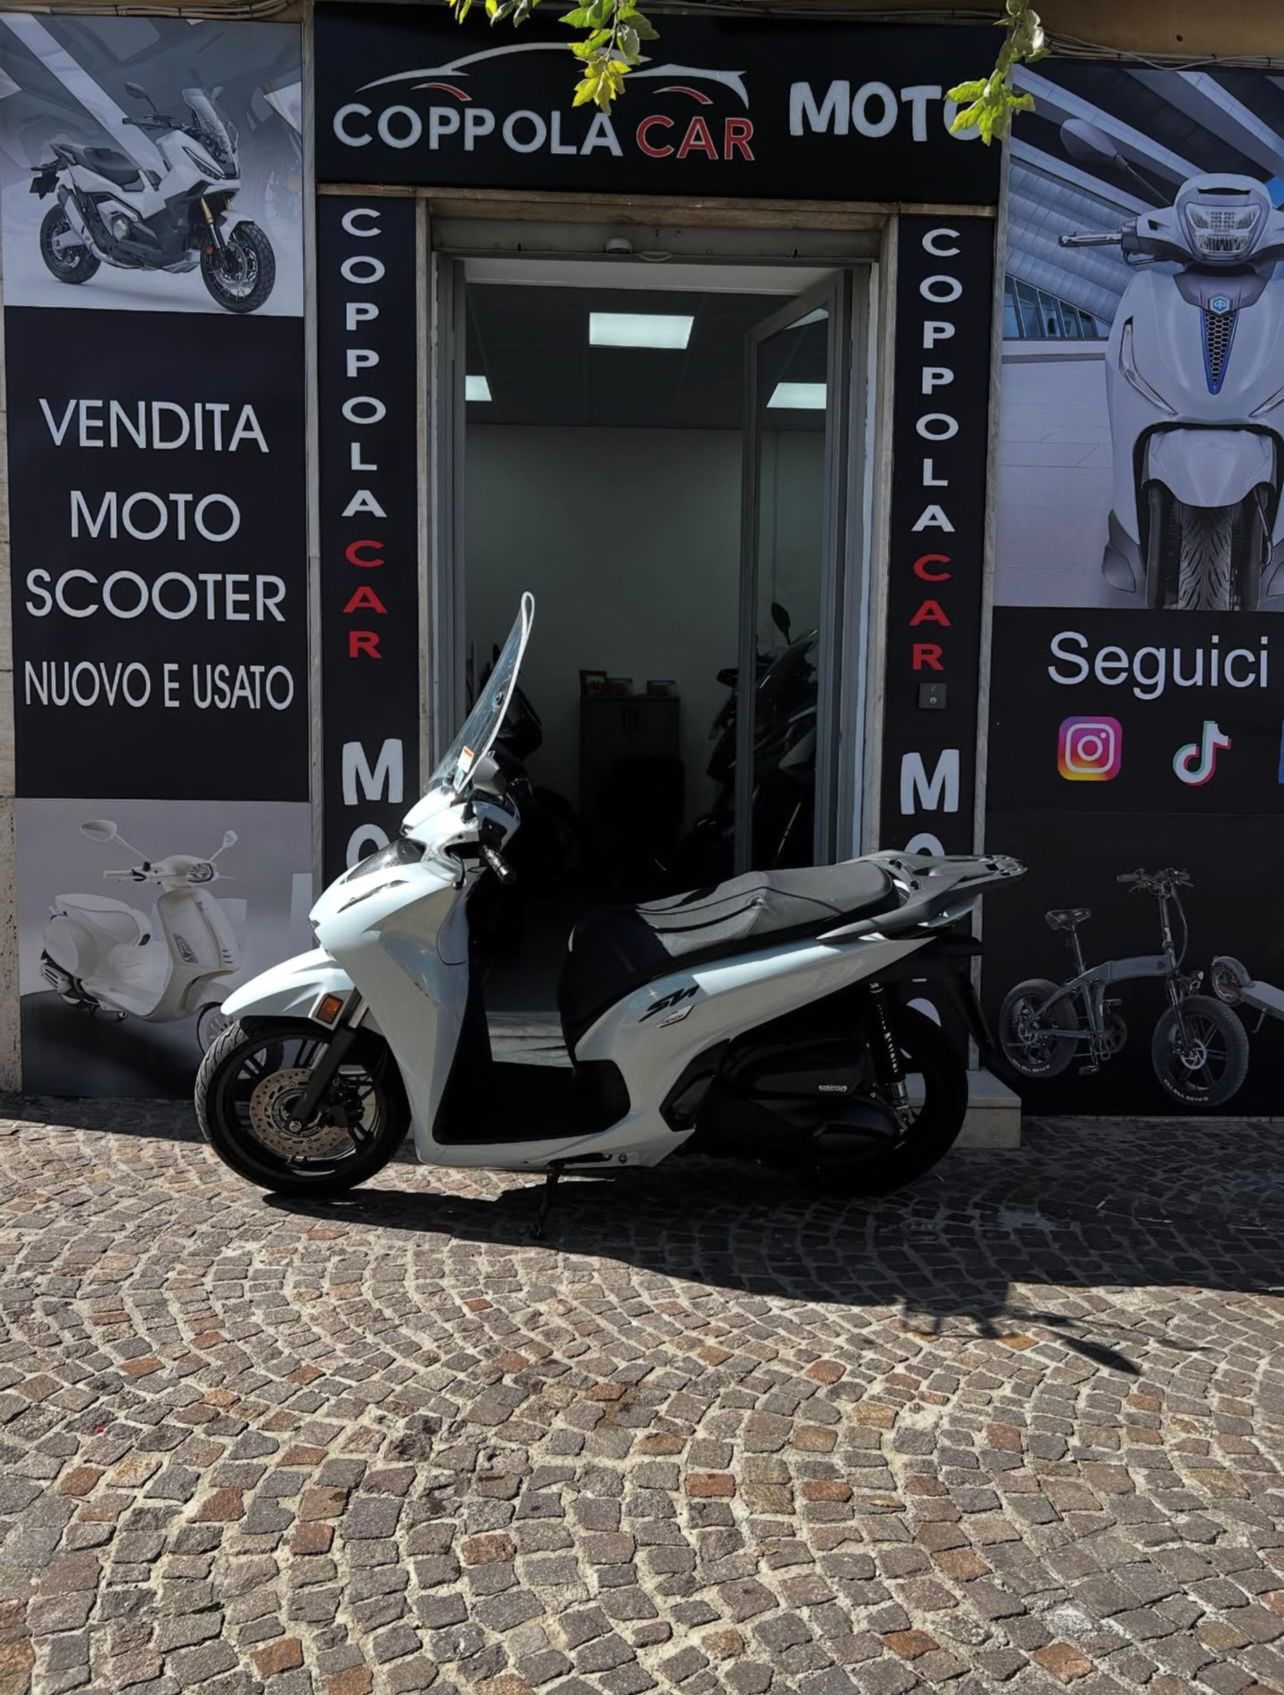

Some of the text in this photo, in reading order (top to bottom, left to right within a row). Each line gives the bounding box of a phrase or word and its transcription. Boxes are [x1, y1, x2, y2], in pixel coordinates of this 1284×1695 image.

[332, 103, 755, 161] COPPOLA CAR
[38, 398, 270, 454] VENDITA
[340, 208, 388, 659] COPPOLA CAR
[908, 228, 963, 671] COPPOLA CAR
[70, 490, 241, 542] MOTO
[25, 568, 287, 622] SCOOTER
[24, 661, 294, 710] NUOVO E USATO
[1047, 631, 1269, 700] Seguici
